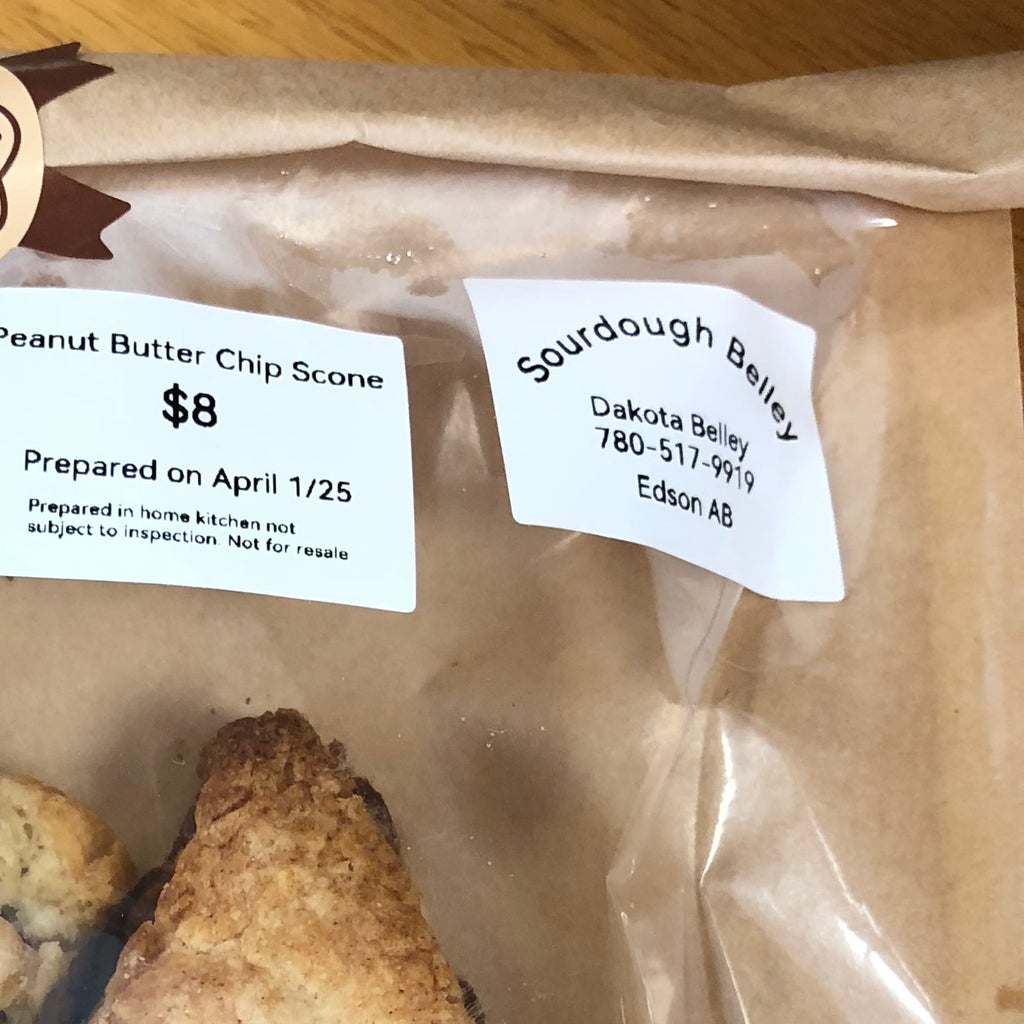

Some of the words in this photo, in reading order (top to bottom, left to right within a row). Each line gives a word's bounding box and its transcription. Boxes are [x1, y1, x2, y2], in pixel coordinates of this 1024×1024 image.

[110, 333, 207, 365] Butter
[215, 348, 283, 384] Chip
[291, 361, 384, 389] Scone
[517, 314, 714, 383] Sourdough
[726, 336, 798, 442] Belley
[161, 382, 218, 429] $8
[591, 395, 683, 432] Dakota
[691, 414, 749, 461] Belley
[24, 449, 158, 481] Prepared
[167, 466, 202, 487] on
[212, 466, 277, 497] April
[289, 476, 352, 503] 1/25
[595, 427, 755, 493] 780-517-9919
[28, 498, 111, 517] Prepared
[118, 503, 134, 519] in
[140, 505, 190, 524] home
[196, 511, 261, 532] kitchen
[266, 520, 296, 535] not
[637, 474, 702, 516] Edson
[708, 501, 734, 528] AB
[27, 521, 94, 540] subject
[99, 524, 118, 538] to
[228, 534, 260, 551] Not
[266, 538, 290, 554] for
[296, 545, 349, 561] resale
